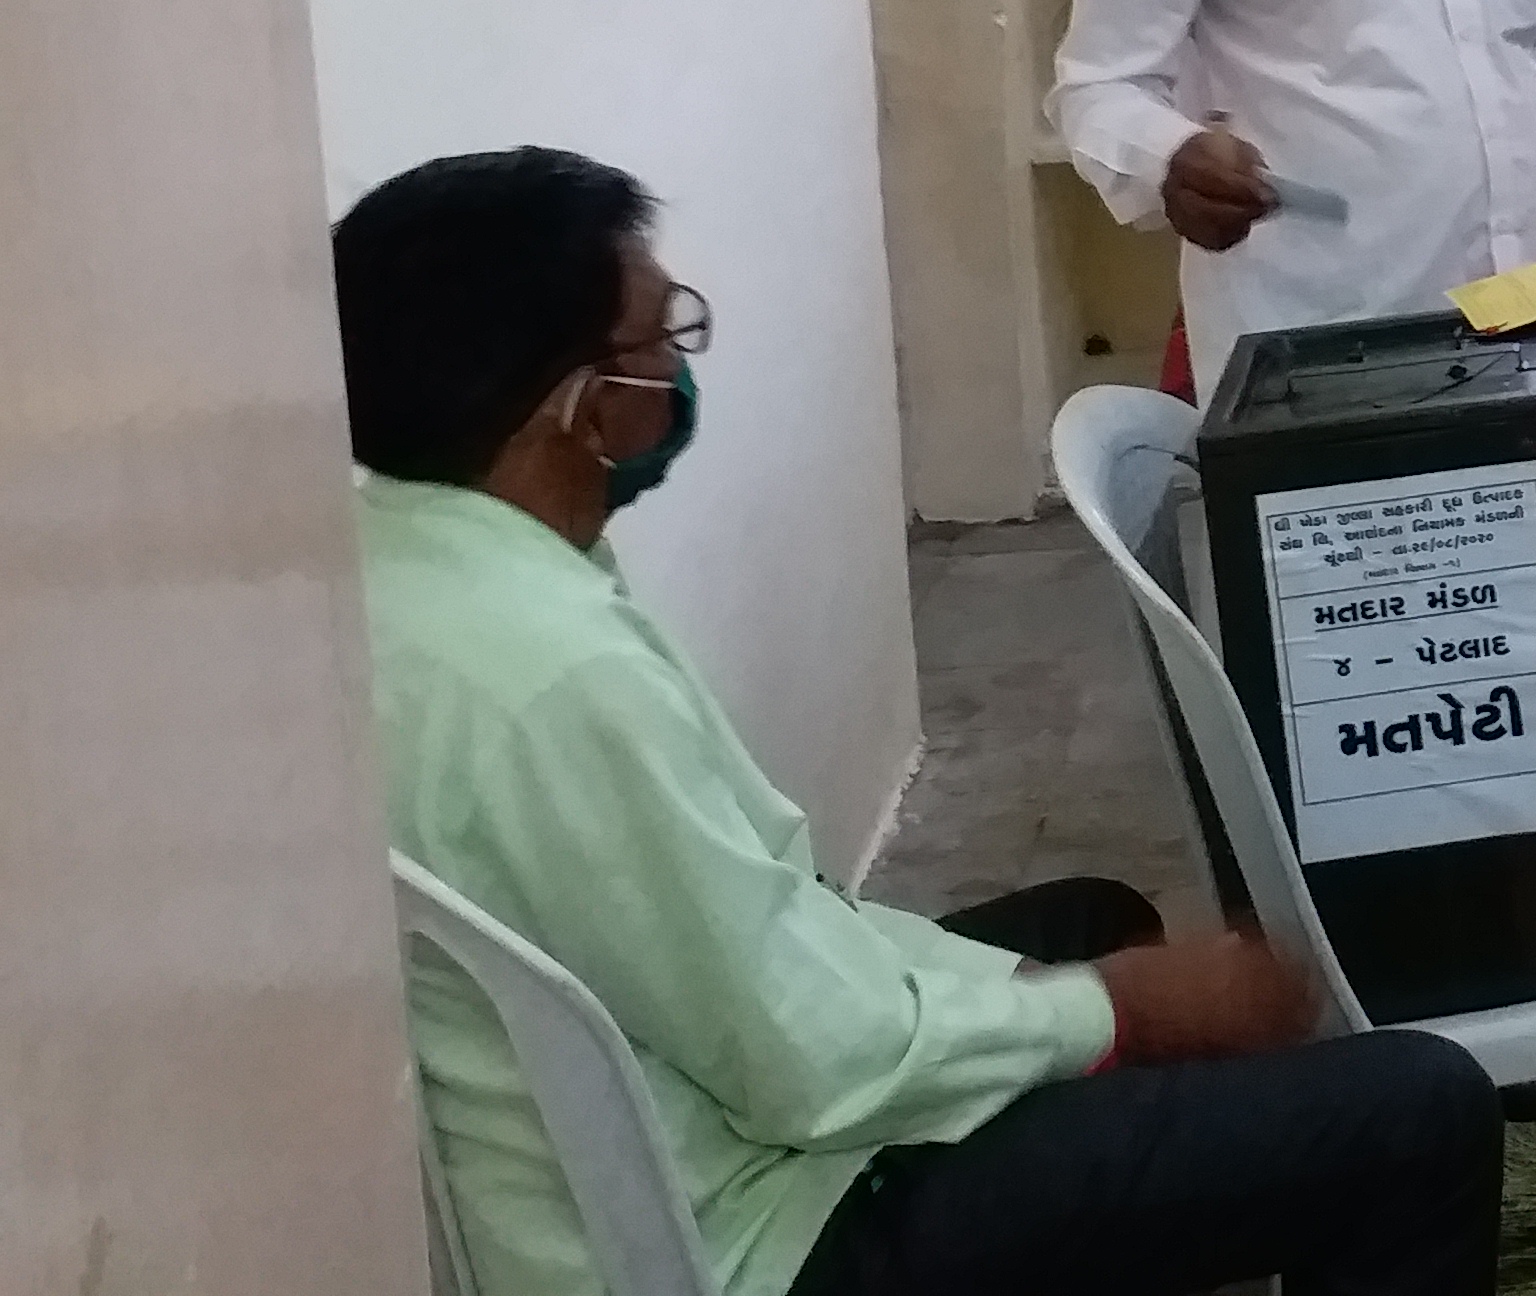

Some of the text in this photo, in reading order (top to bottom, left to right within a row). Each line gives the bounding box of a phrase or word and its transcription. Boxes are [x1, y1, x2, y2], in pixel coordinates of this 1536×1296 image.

[1381, 498, 1433, 517] સહકારી
[1441, 496, 1463, 513] દૂધ
[1472, 488, 1524, 505] ઉત્પાદક
[1412, 516, 1466, 533] નિયામક
[1474, 505, 1525, 524] મંડળની
[1313, 581, 1498, 625] મતદાર મંડળ
[1333, 656, 1352, 677] ૪
[1415, 634, 1511, 665] પેટલાદ
[1338, 684, 1524, 758] મતપેટી
